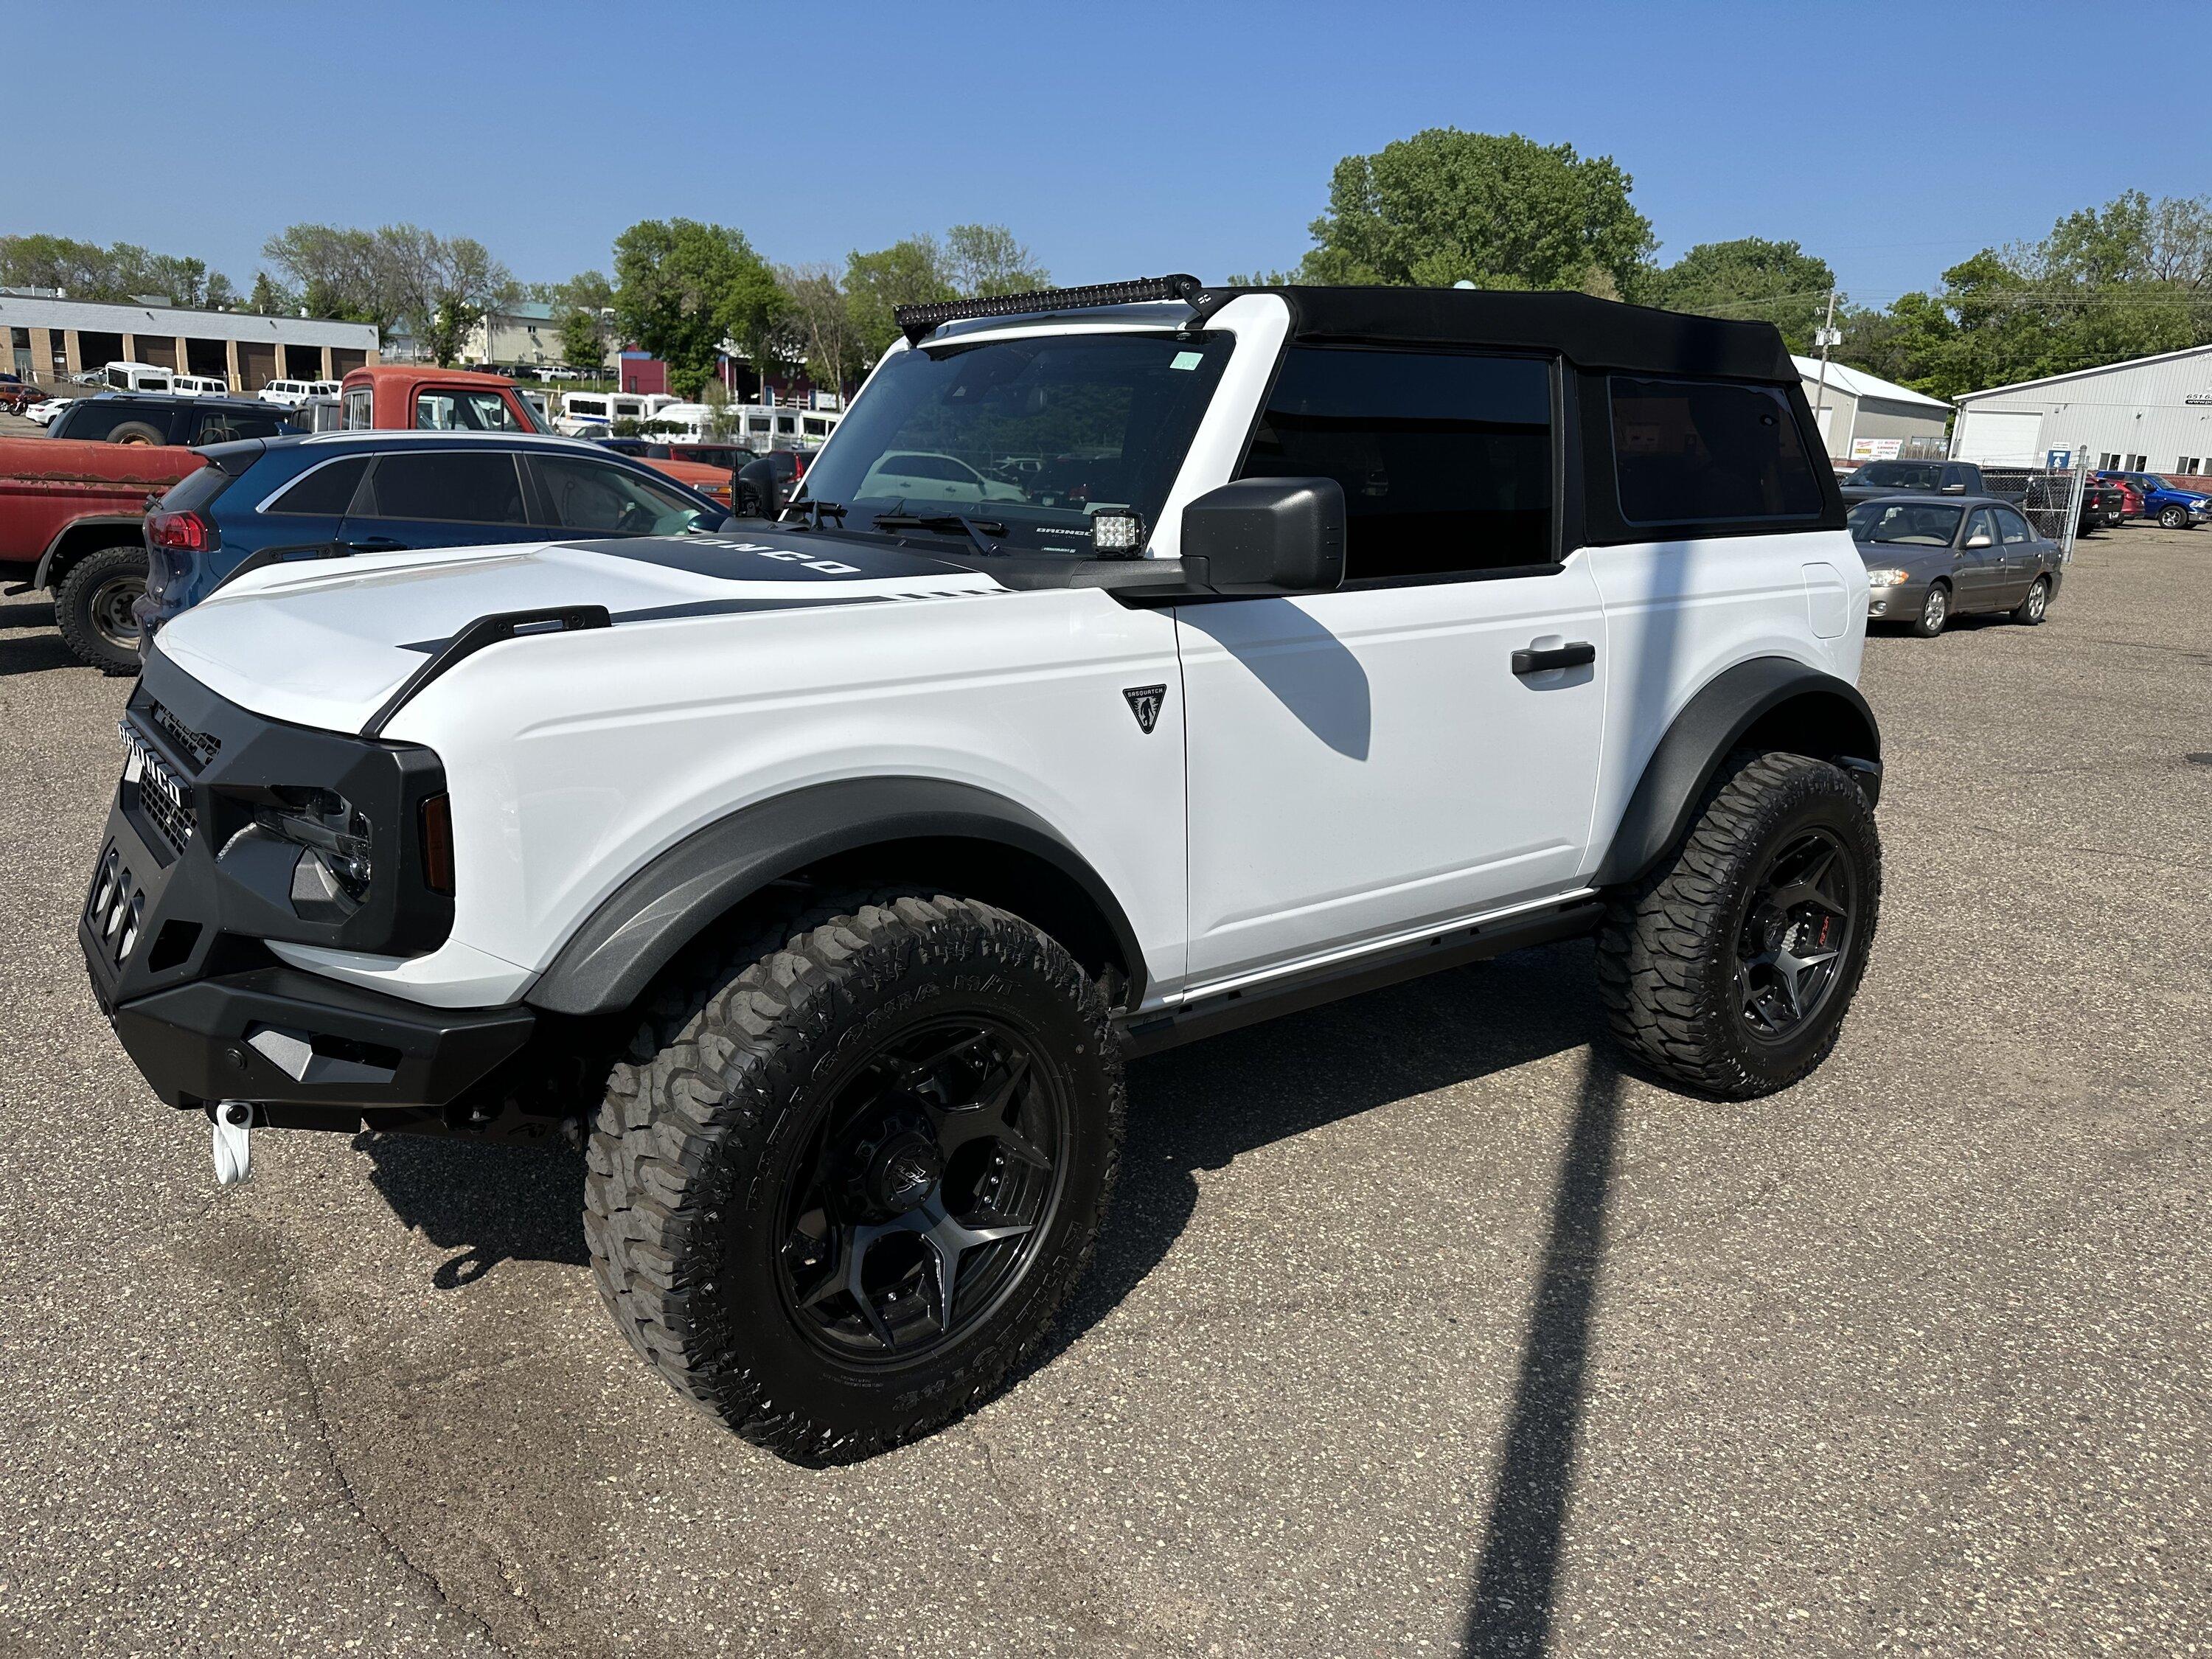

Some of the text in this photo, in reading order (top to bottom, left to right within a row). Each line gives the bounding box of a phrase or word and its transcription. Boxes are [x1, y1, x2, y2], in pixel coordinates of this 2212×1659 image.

[1127, 688, 1164, 698] SASQUATCH
[118, 722, 181, 808] BRONCO
[953, 973, 1023, 995] M/T
